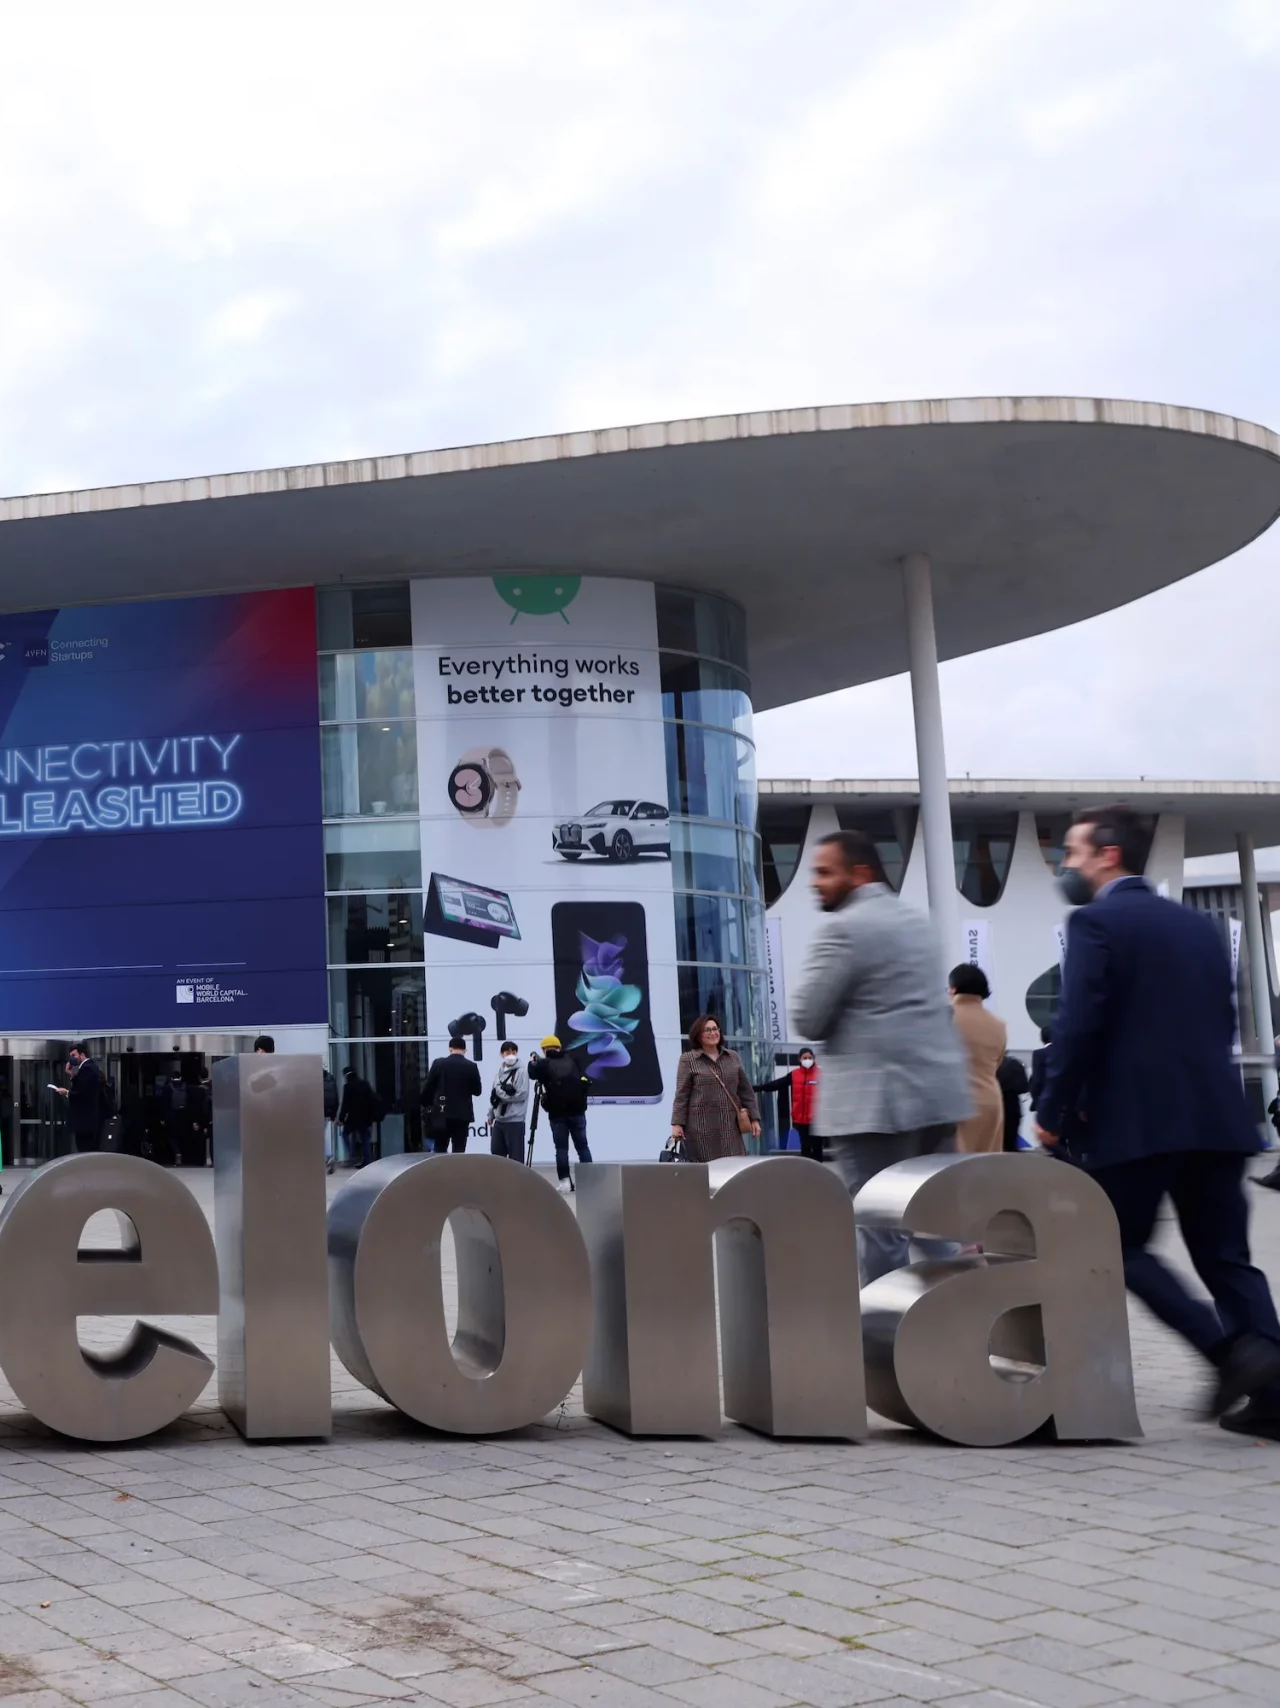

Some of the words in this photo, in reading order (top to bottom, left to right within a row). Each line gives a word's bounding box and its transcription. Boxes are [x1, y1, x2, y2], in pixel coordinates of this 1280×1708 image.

[50, 637, 109, 650] Connecting
[25, 649, 47, 658] 4YFN
[50, 650, 93, 662] Startups
[438, 653, 569, 679] Everything
[575, 654, 640, 676] works
[447, 684, 526, 704] better
[531, 682, 635, 707] together
